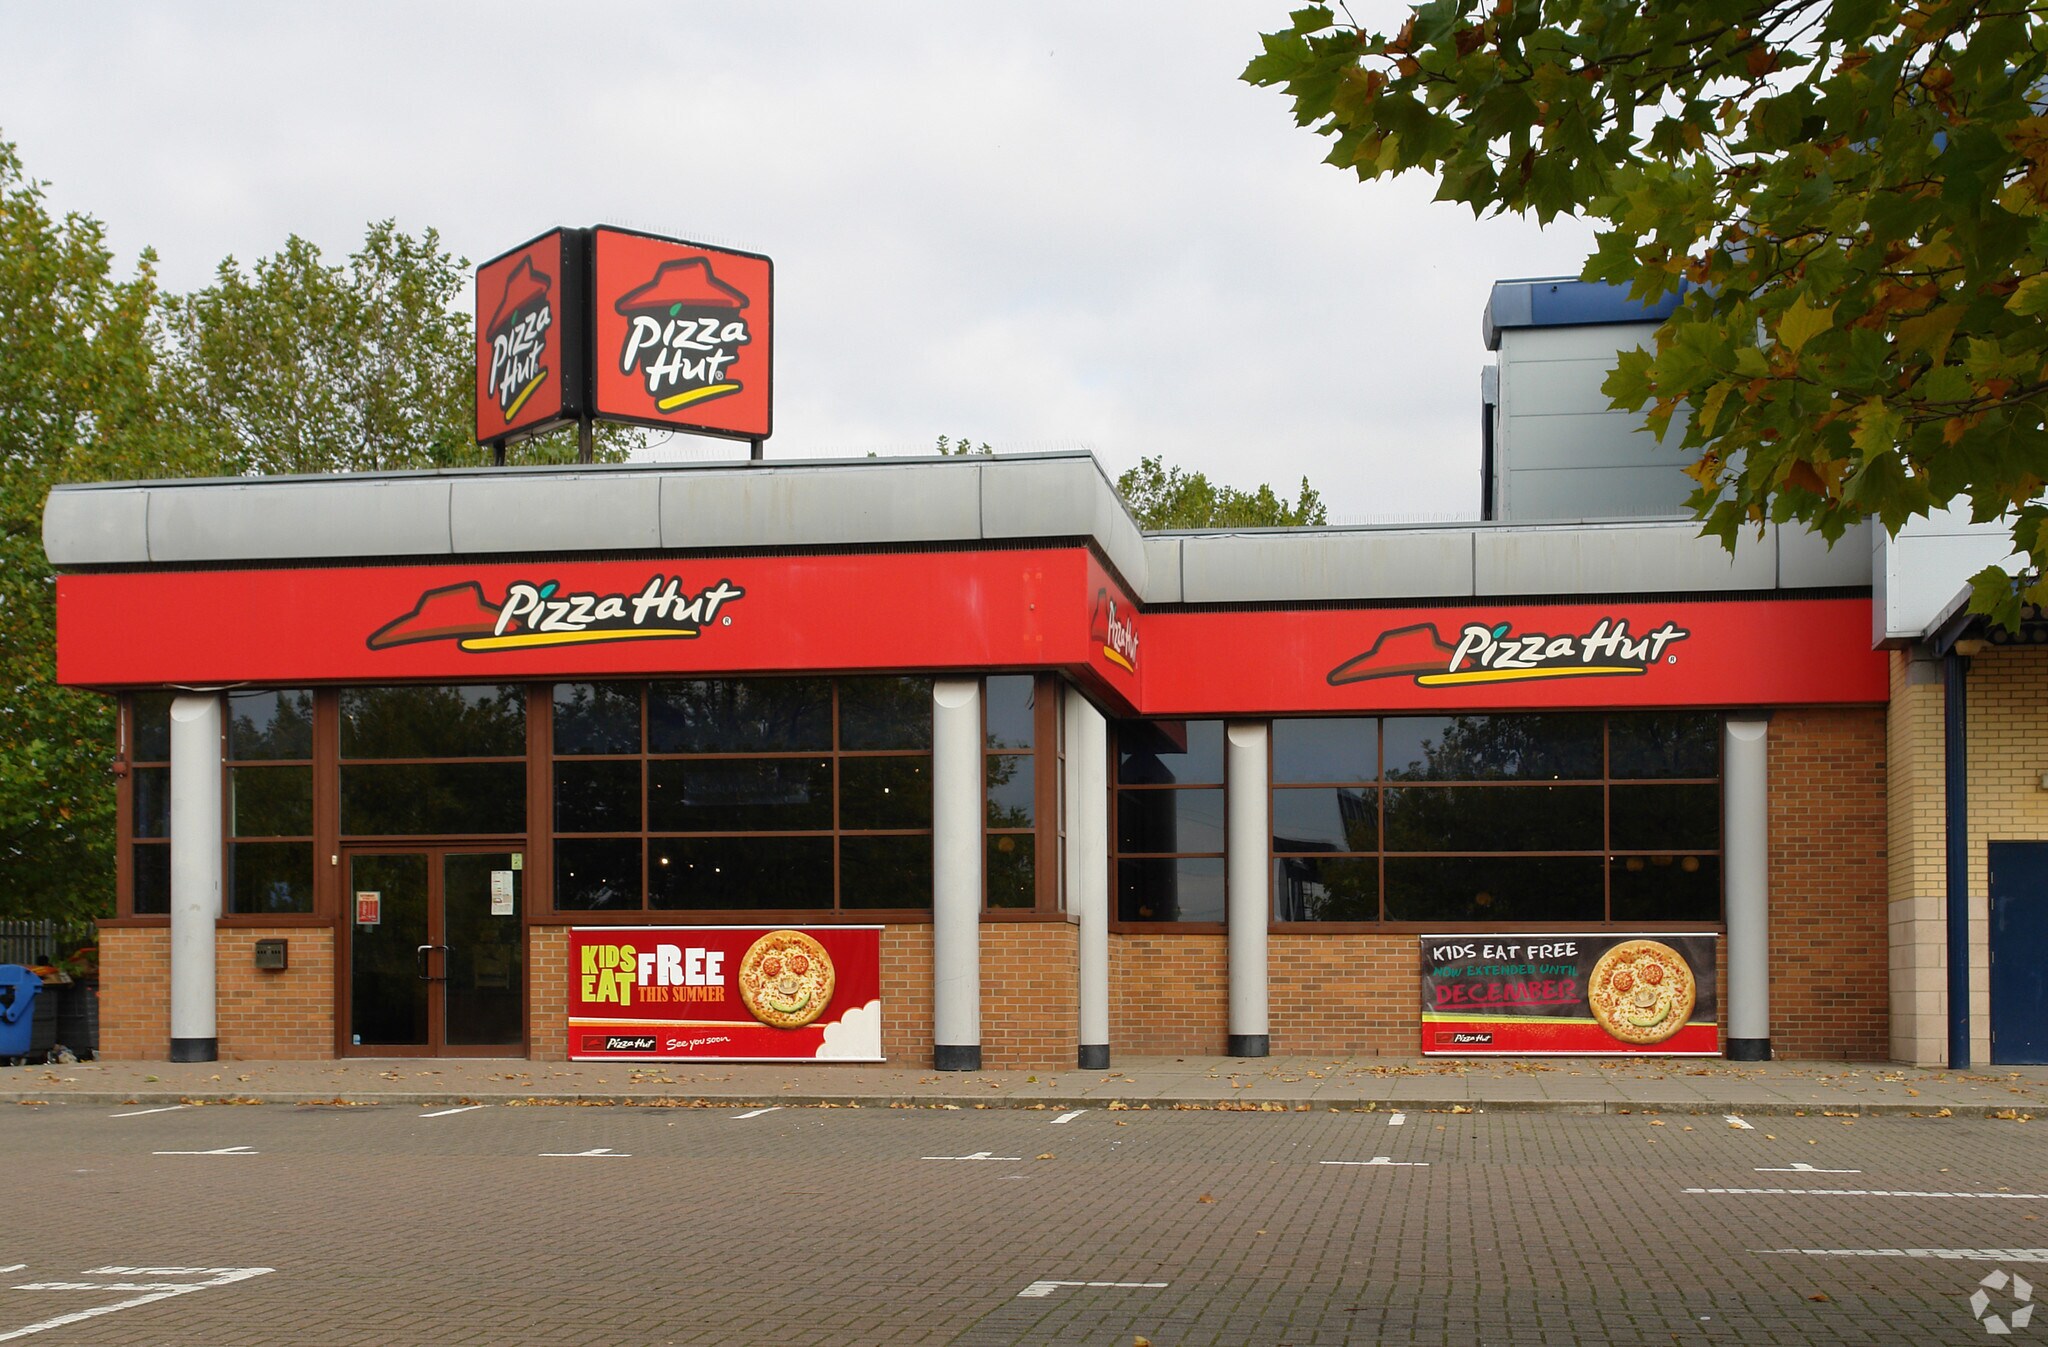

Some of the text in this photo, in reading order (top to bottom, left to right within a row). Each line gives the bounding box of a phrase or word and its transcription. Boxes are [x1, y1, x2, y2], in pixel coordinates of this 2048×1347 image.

[489, 306, 551, 394] Pizza
[623, 302, 748, 371] Pizza
[501, 341, 545, 406] Hut
[645, 348, 735, 391] Hut
[494, 578, 742, 636] Pizza Hut
[1108, 600, 1139, 663] Pizza Hut
[1449, 620, 1686, 672] Pizza Hut
[581, 944, 637, 975] KIDS
[637, 944, 725, 986] FREE
[1433, 942, 1579, 961] KIDS EAT FREE
[1433, 964, 1579, 977] NOW EXTENDED UNTIL
[581, 968, 636, 1006] EAT
[638, 985, 725, 1003] THIS SUMMER
[1435, 979, 1577, 1004] DECEMBER
[607, 1037, 656, 1050] Pizza Hut
[666, 1035, 732, 1051] See you soon
[1454, 1033, 1492, 1043] Pizza Hut
